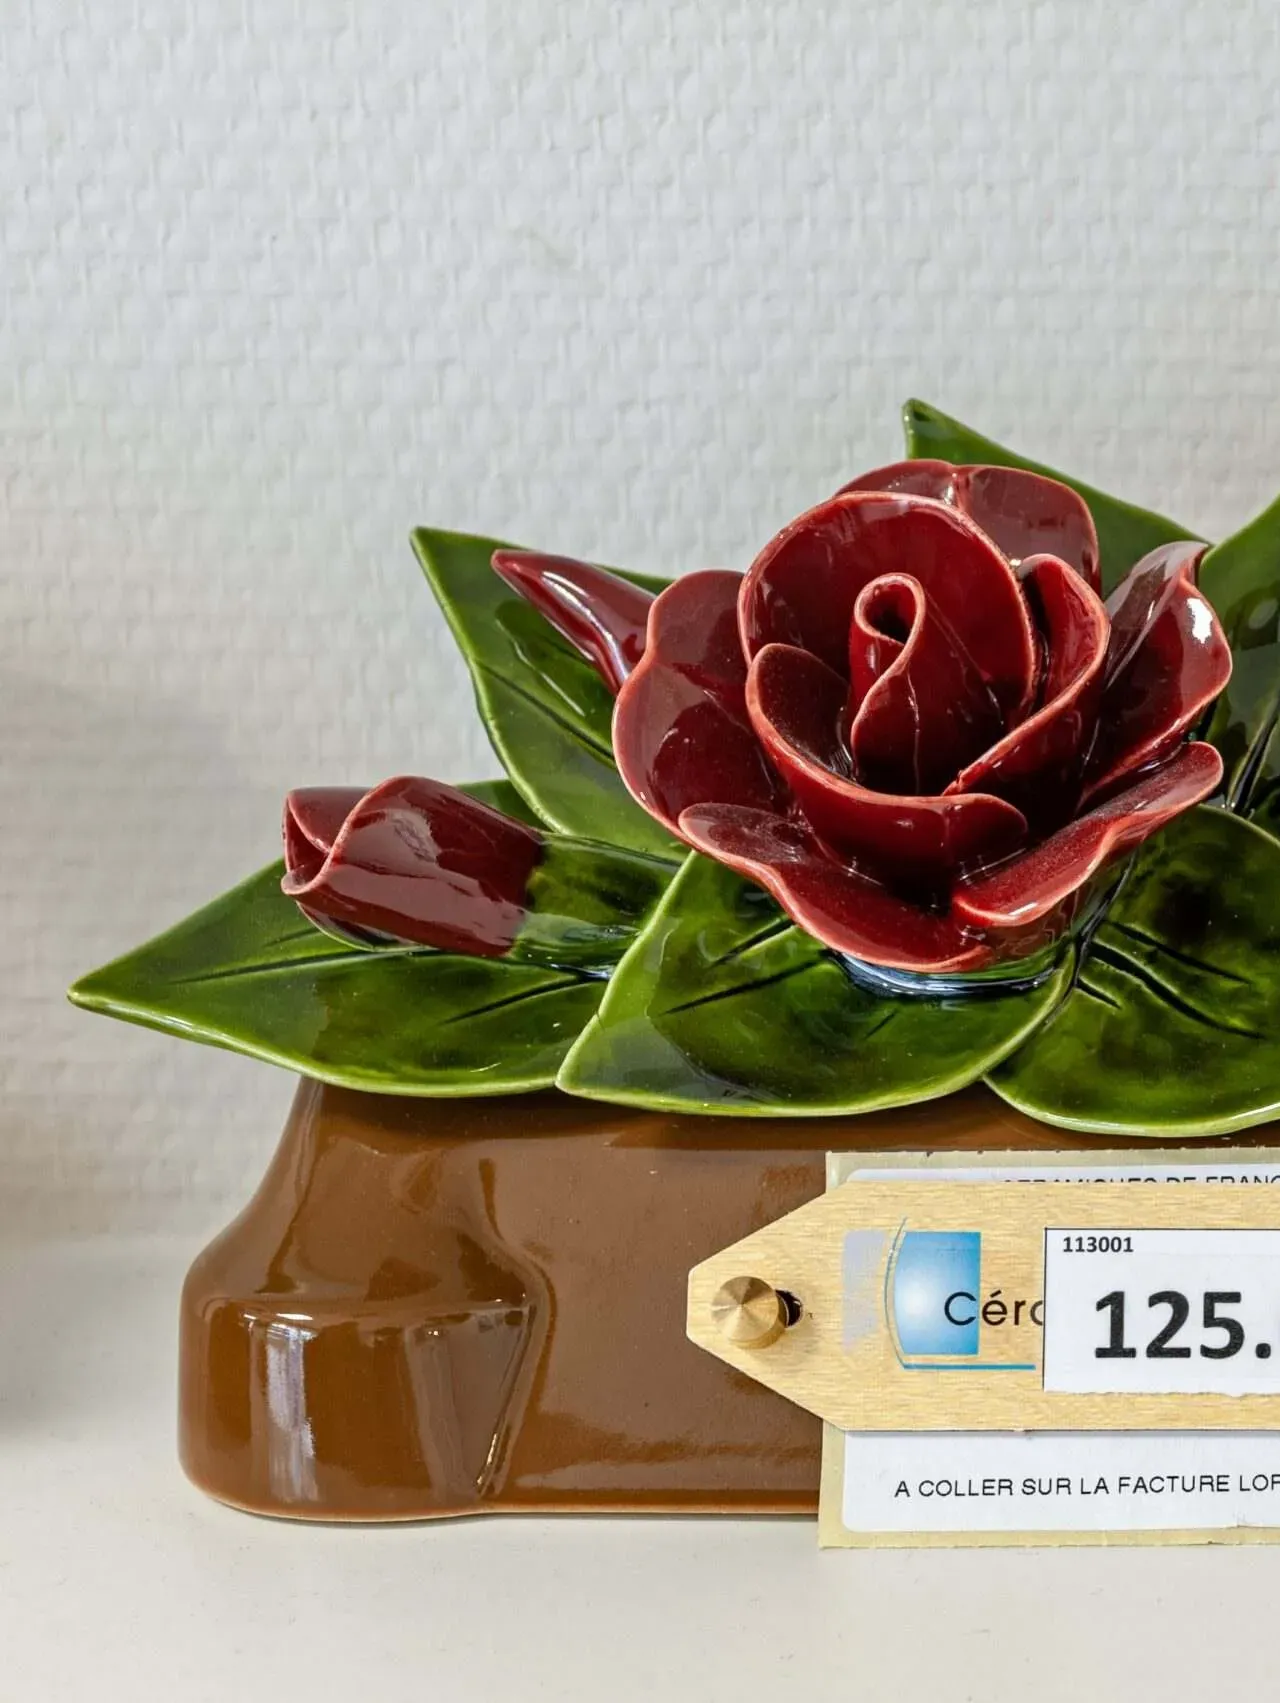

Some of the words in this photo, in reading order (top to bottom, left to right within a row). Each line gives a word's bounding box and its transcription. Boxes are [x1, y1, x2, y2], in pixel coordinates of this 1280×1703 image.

[1063, 1236, 1133, 1253] 113001
[894, 1480, 911, 1498] A
[918, 1478, 1014, 1498] COLLER
[1021, 1477, 1072, 1496] SUR
[1080, 1477, 1110, 1495] LA
[1118, 1474, 1230, 1494] FACTURE
